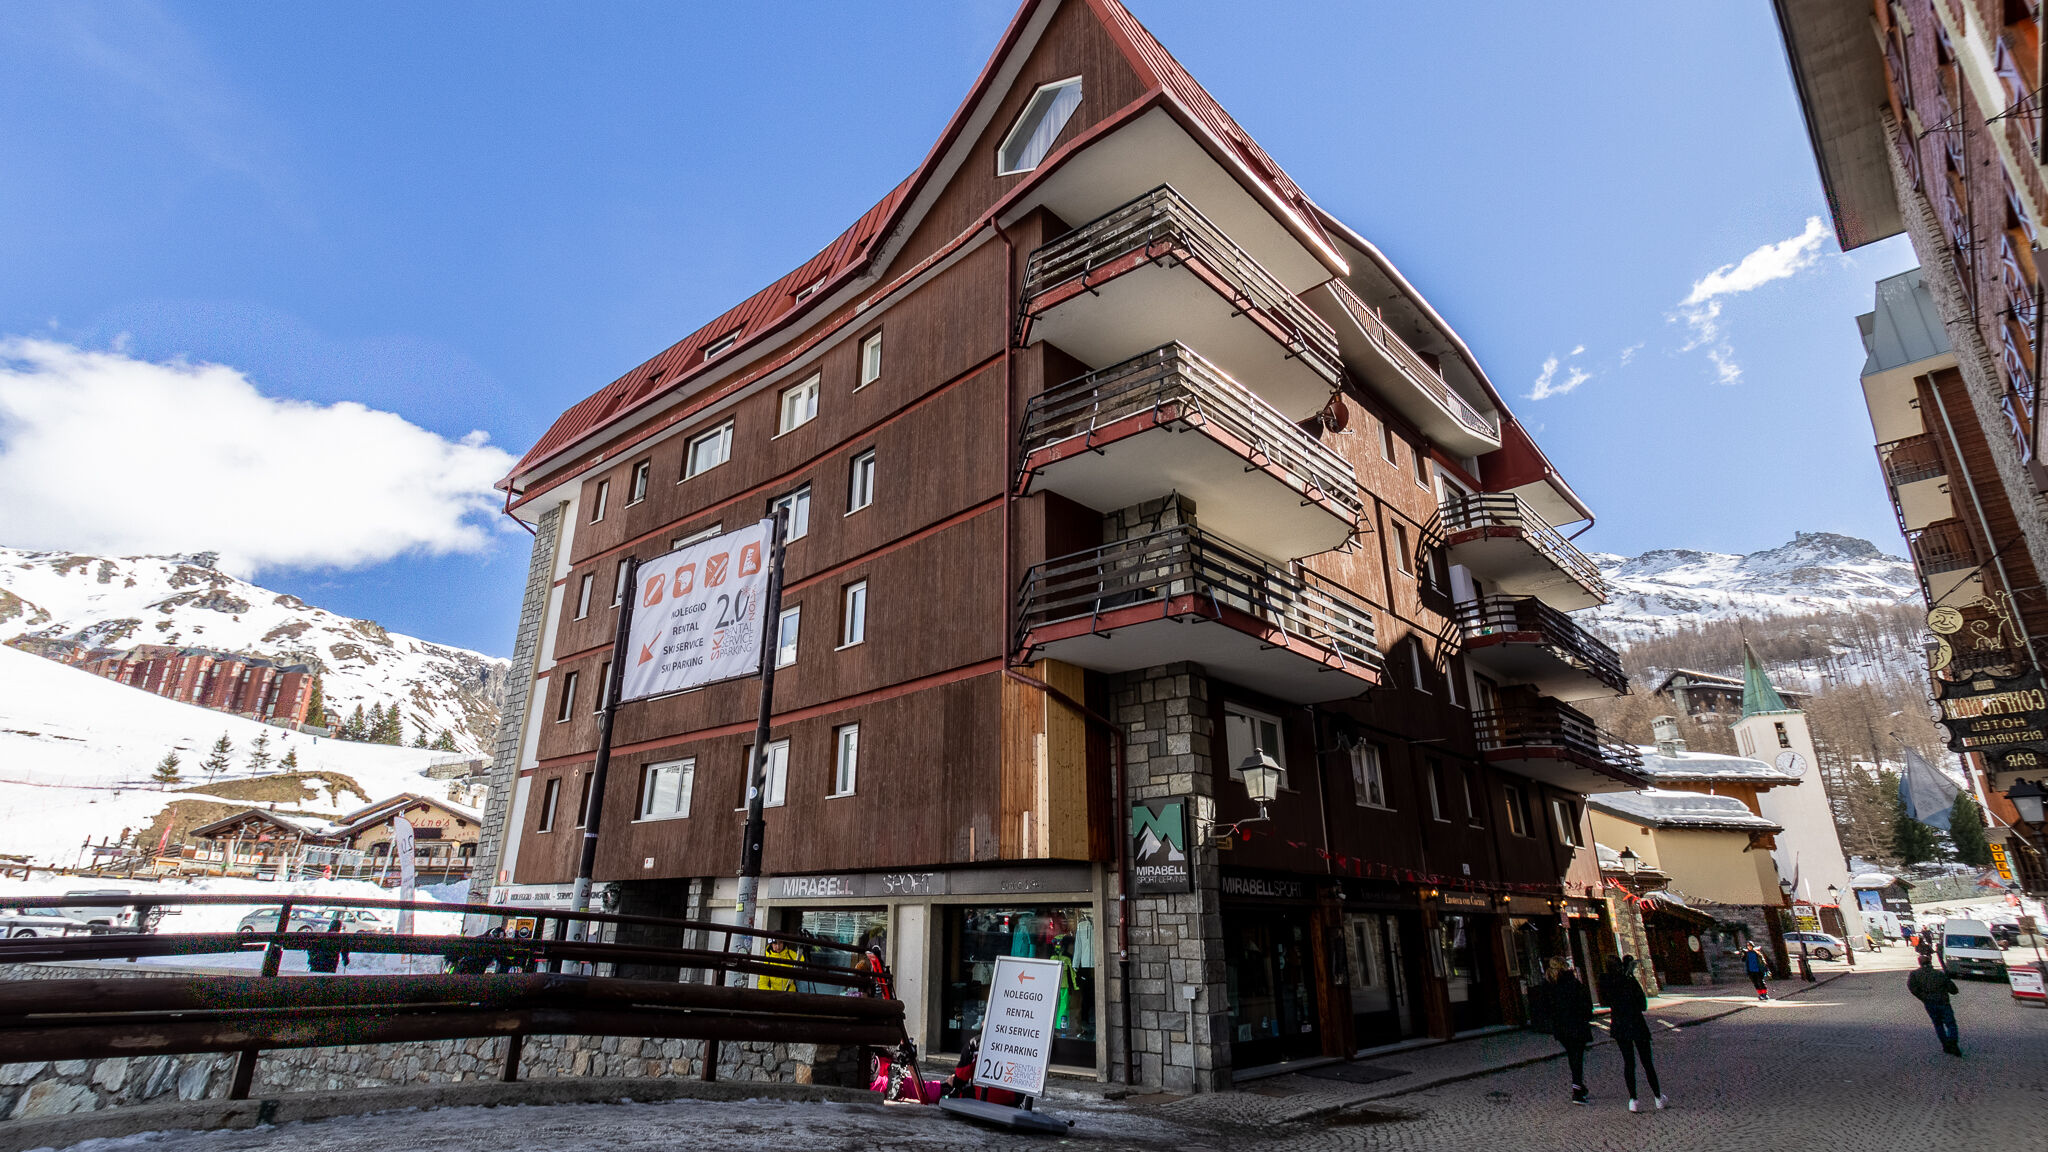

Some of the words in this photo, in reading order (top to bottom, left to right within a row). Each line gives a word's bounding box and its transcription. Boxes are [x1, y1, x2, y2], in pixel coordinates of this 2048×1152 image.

[671, 602, 707, 620] NOLEGGIO
[715, 588, 750, 629] 2.0
[672, 622, 700, 636] RENTAL
[663, 643, 677, 655] SKI
[675, 638, 704, 653] SERVICE
[710, 630, 725, 661] SKI
[661, 663, 672, 674] SKI
[671, 656, 703, 672] PARKING
[1136, 865, 1187, 876] MIRABELL
[783, 877, 854, 896] MIRABELL
[882, 872, 934, 894] SPORT
[1137, 876, 1157, 884] SPORT
[1003, 989, 1043, 1002] NOLEGGIO
[1005, 1007, 1034, 1019] RENTAL
[995, 1025, 1008, 1034] SKI
[1009, 1027, 1040, 1039] SERVICE
[990, 1042, 1003, 1052] SKI
[1003, 1044, 1038, 1058] PARKING
[981, 1058, 1004, 1081] 2.0
[1003, 1061, 1015, 1083] SKI
